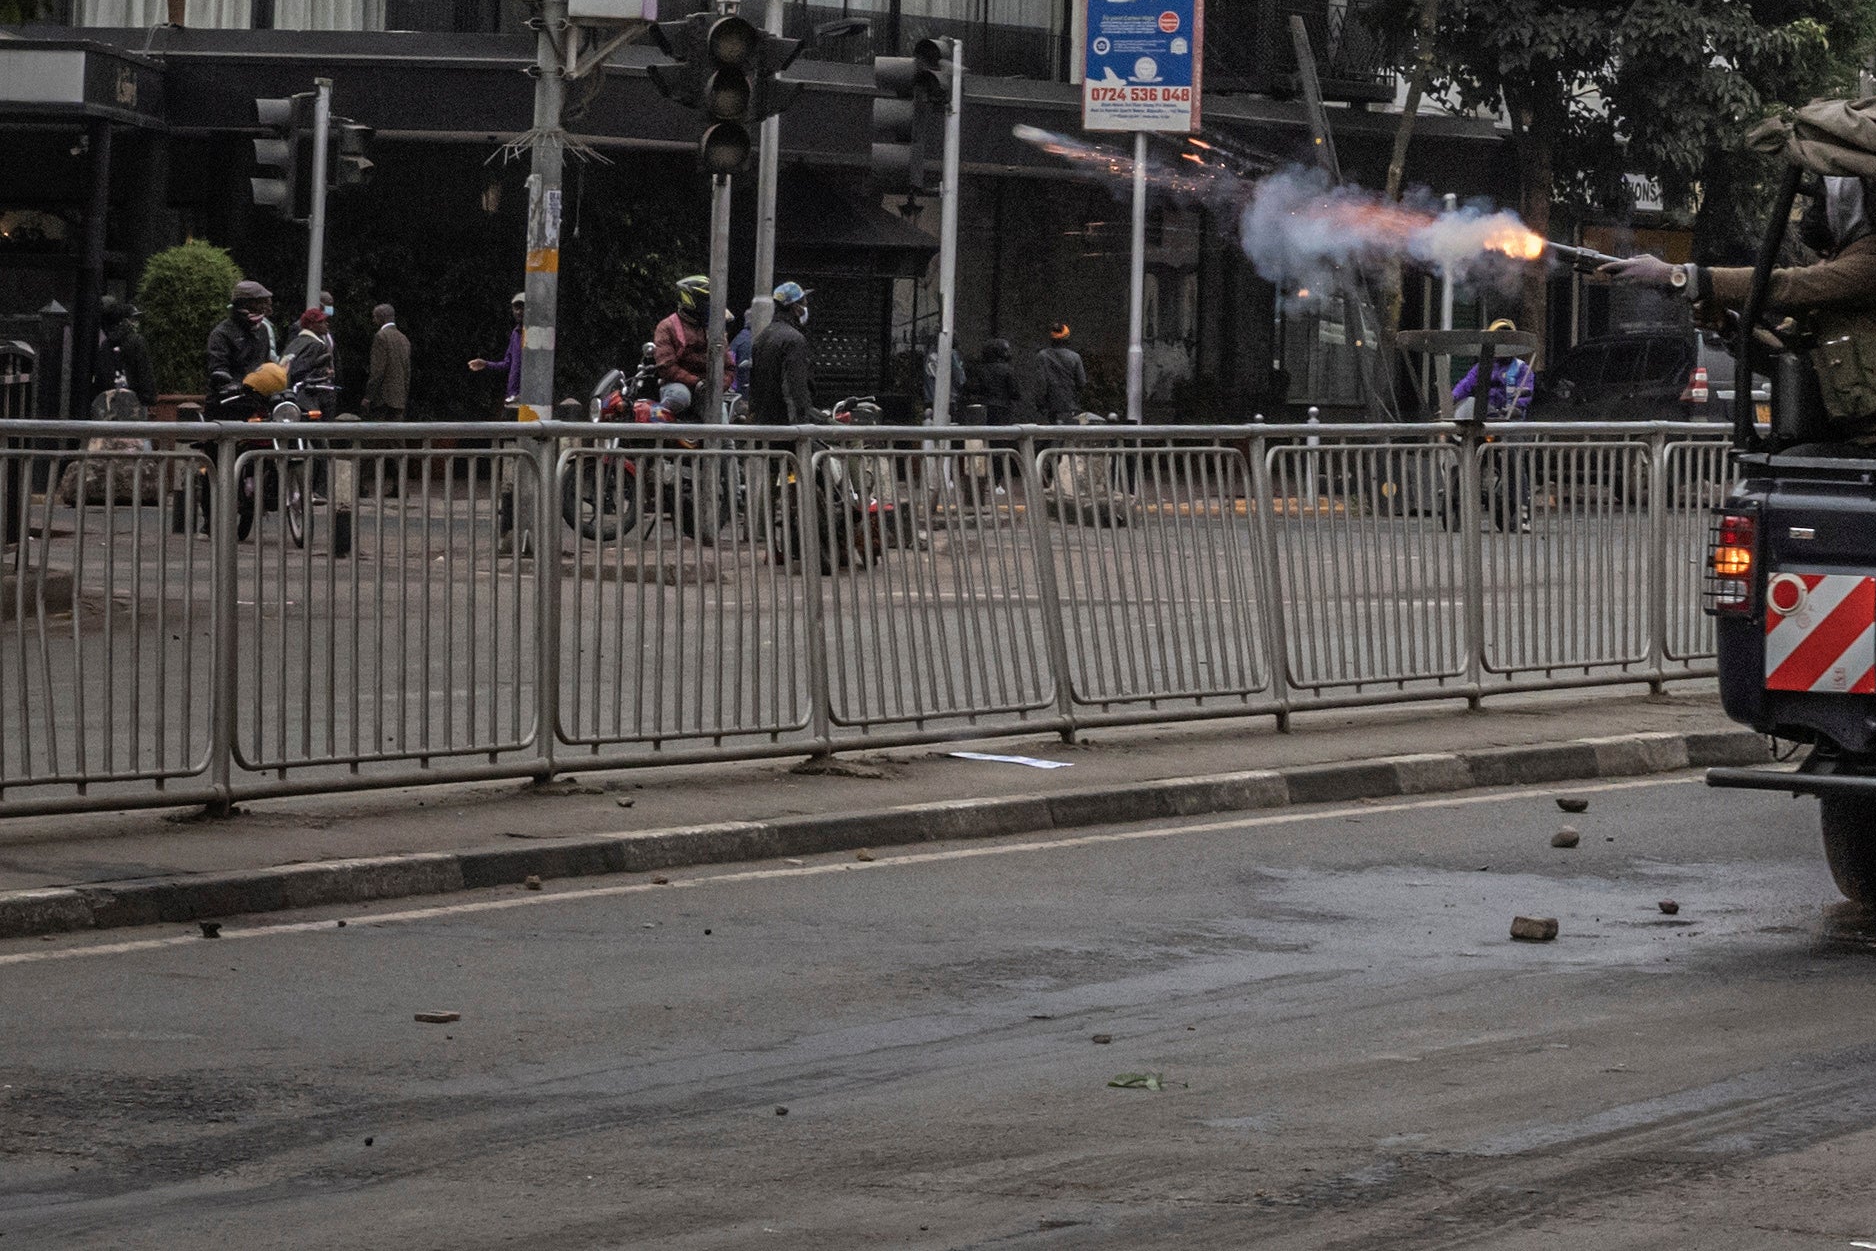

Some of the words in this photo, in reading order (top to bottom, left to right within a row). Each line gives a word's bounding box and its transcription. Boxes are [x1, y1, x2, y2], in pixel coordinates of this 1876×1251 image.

[1091, 88, 1127, 102] 0724
[1131, 88, 1158, 102] 536
[1162, 88, 1190, 102] 048
